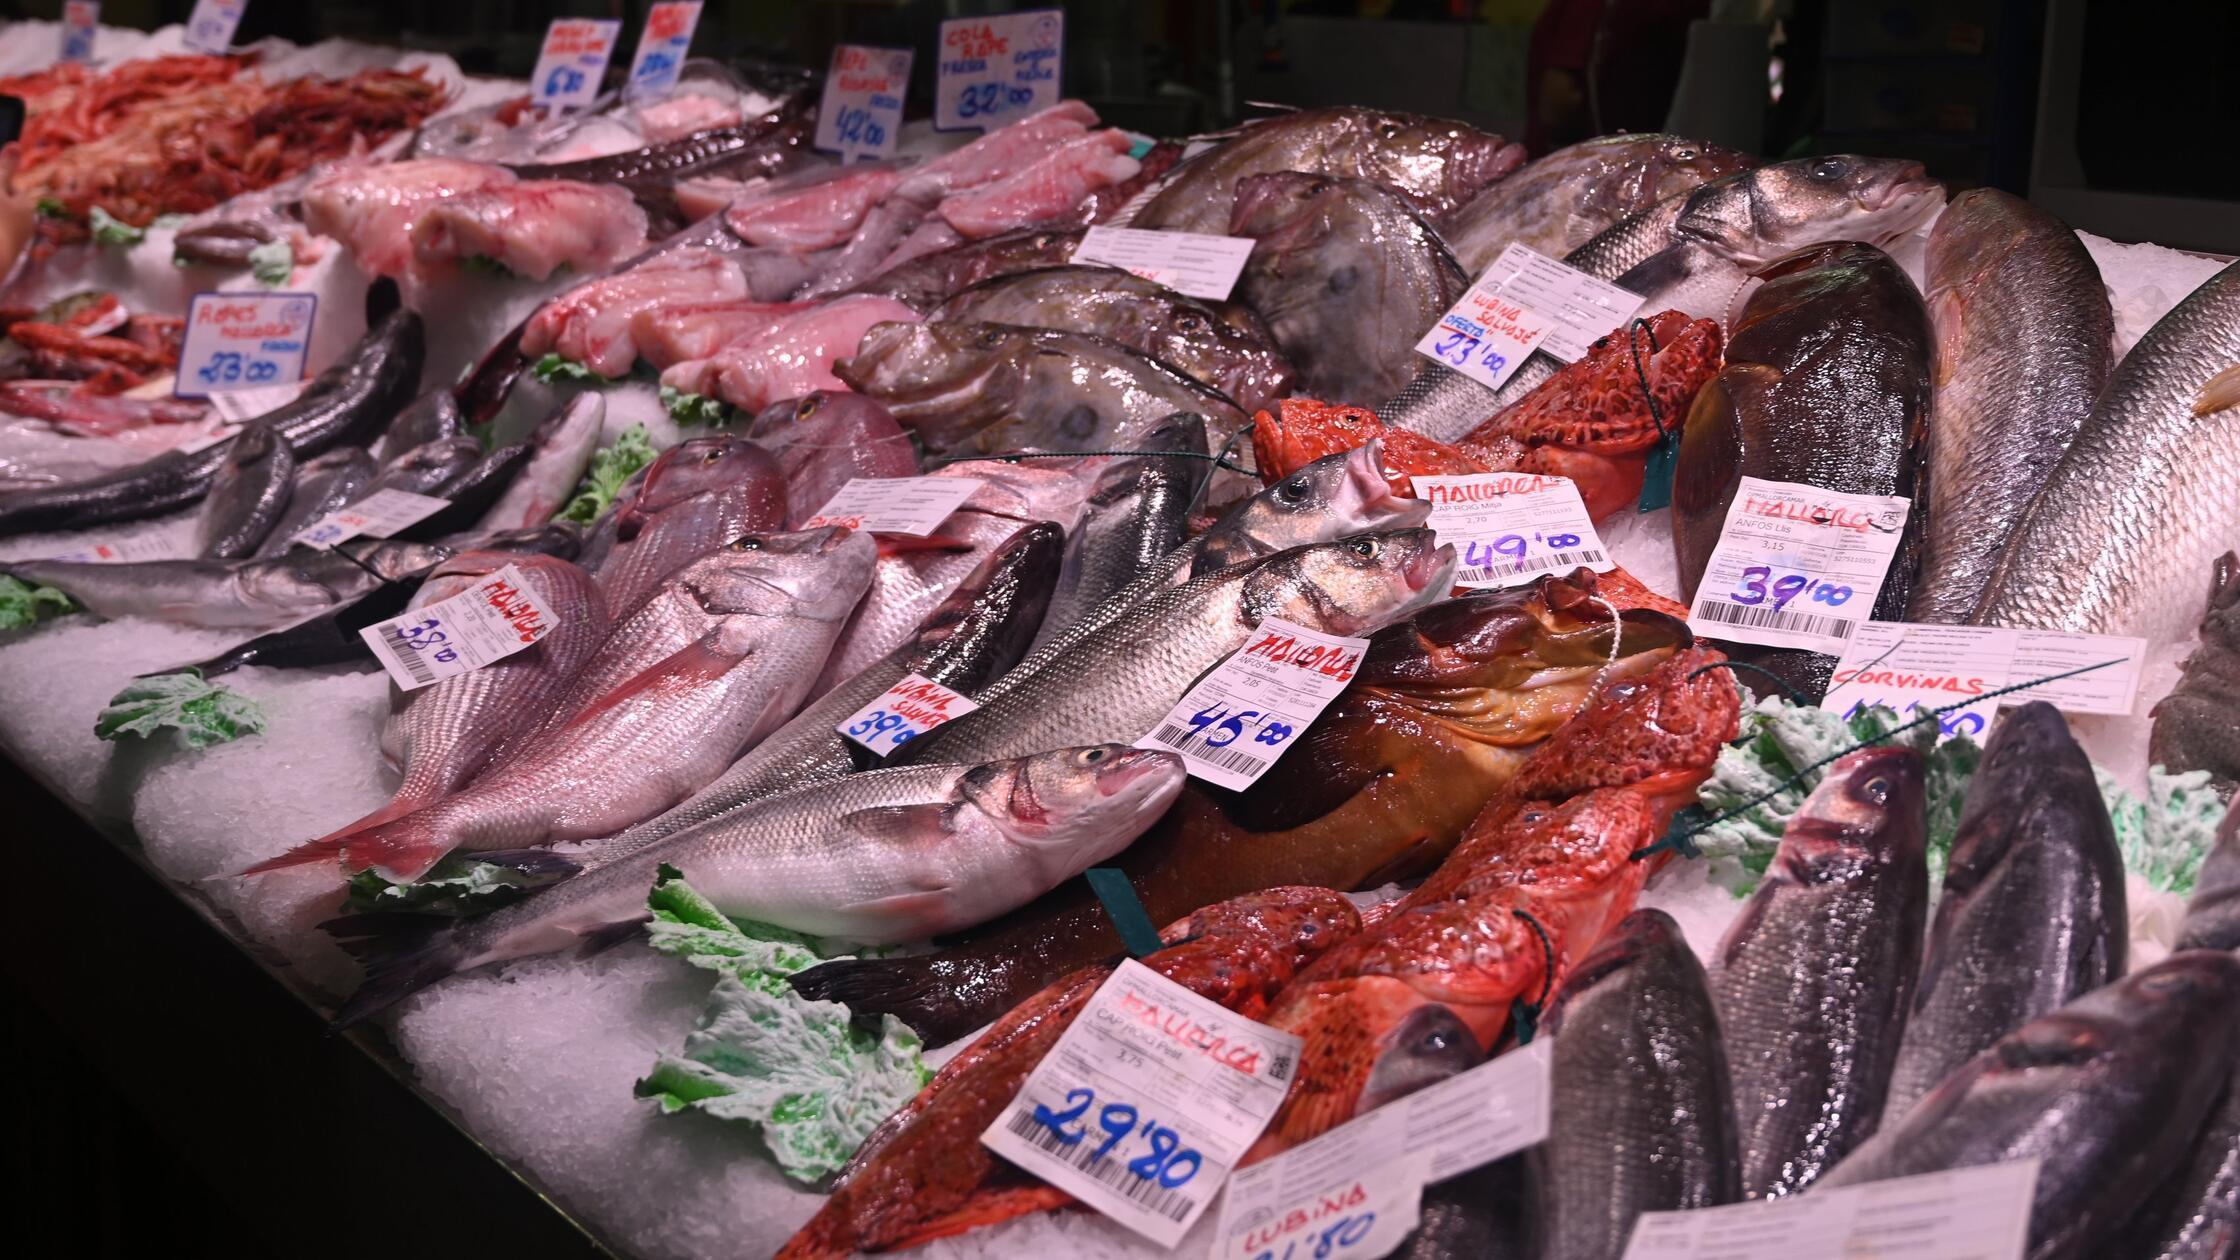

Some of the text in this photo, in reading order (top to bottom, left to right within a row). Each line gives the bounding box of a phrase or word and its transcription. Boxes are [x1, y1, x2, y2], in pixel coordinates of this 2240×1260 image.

[945, 23, 993, 46] COLA
[962, 37, 1008, 57] RAPE
[957, 82, 1034, 118] 32'00
[1473, 294, 1521, 322] LUBINA
[1428, 475, 1556, 504] MALLORCA
[1735, 517, 1773, 531] ANFOS
[1464, 532, 1581, 573] 49'00
[1762, 540, 1785, 551] 3,15
[1731, 565, 1853, 613] 39'00
[1238, 655, 1262, 669] ANFOS
[1834, 669, 1985, 695] CORVINAS
[1097, 1008, 1124, 1026] CAP
[1116, 1049, 1145, 1068] 3,75
[1034, 1088, 1202, 1189] 29'80
[1244, 1181, 1368, 1253] LUBINA
